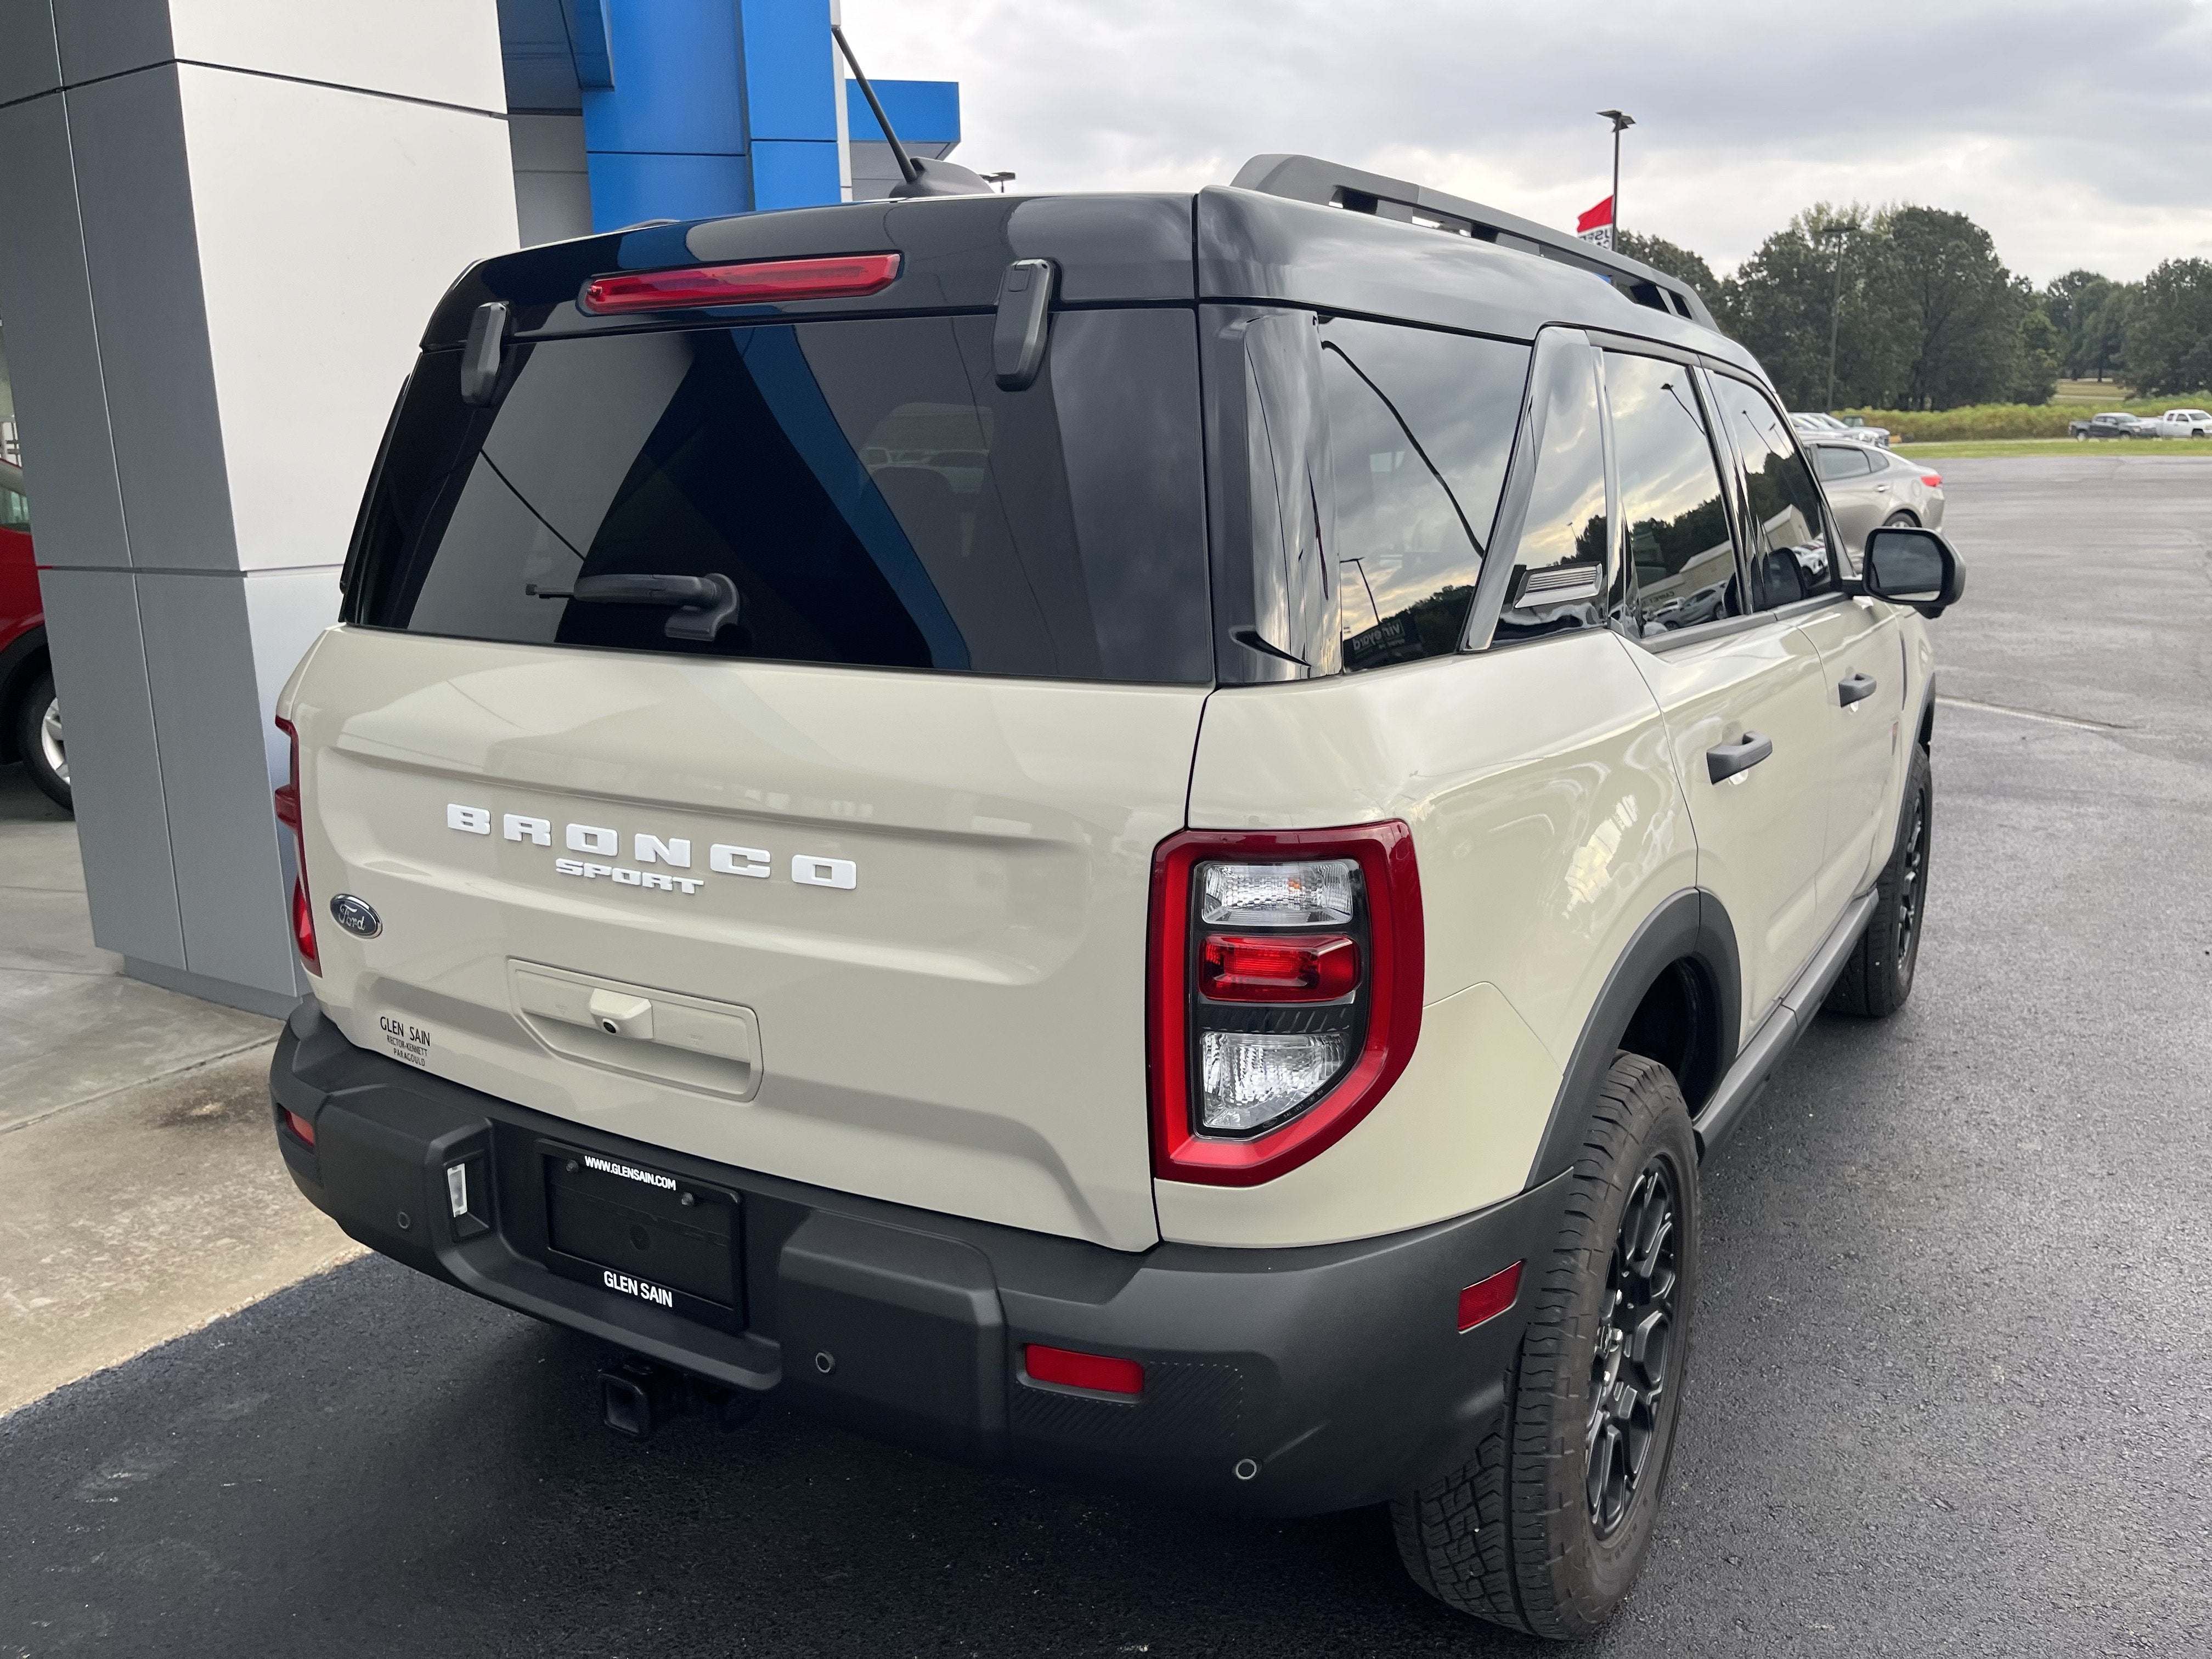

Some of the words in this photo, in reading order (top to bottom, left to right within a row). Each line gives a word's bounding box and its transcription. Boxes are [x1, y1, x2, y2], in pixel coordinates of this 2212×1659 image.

[447, 803, 858, 890] BRONCO
[555, 857, 705, 894] SPORT
[338, 904, 366, 931] Ford
[380, 1017, 404, 1037] GLEN
[410, 1026, 431, 1046] SAIN
[584, 1155, 676, 1190] WWW.GLENSAIN.COM
[603, 1271, 638, 1296] GLEN
[640, 1283, 673, 1307] SAIN
